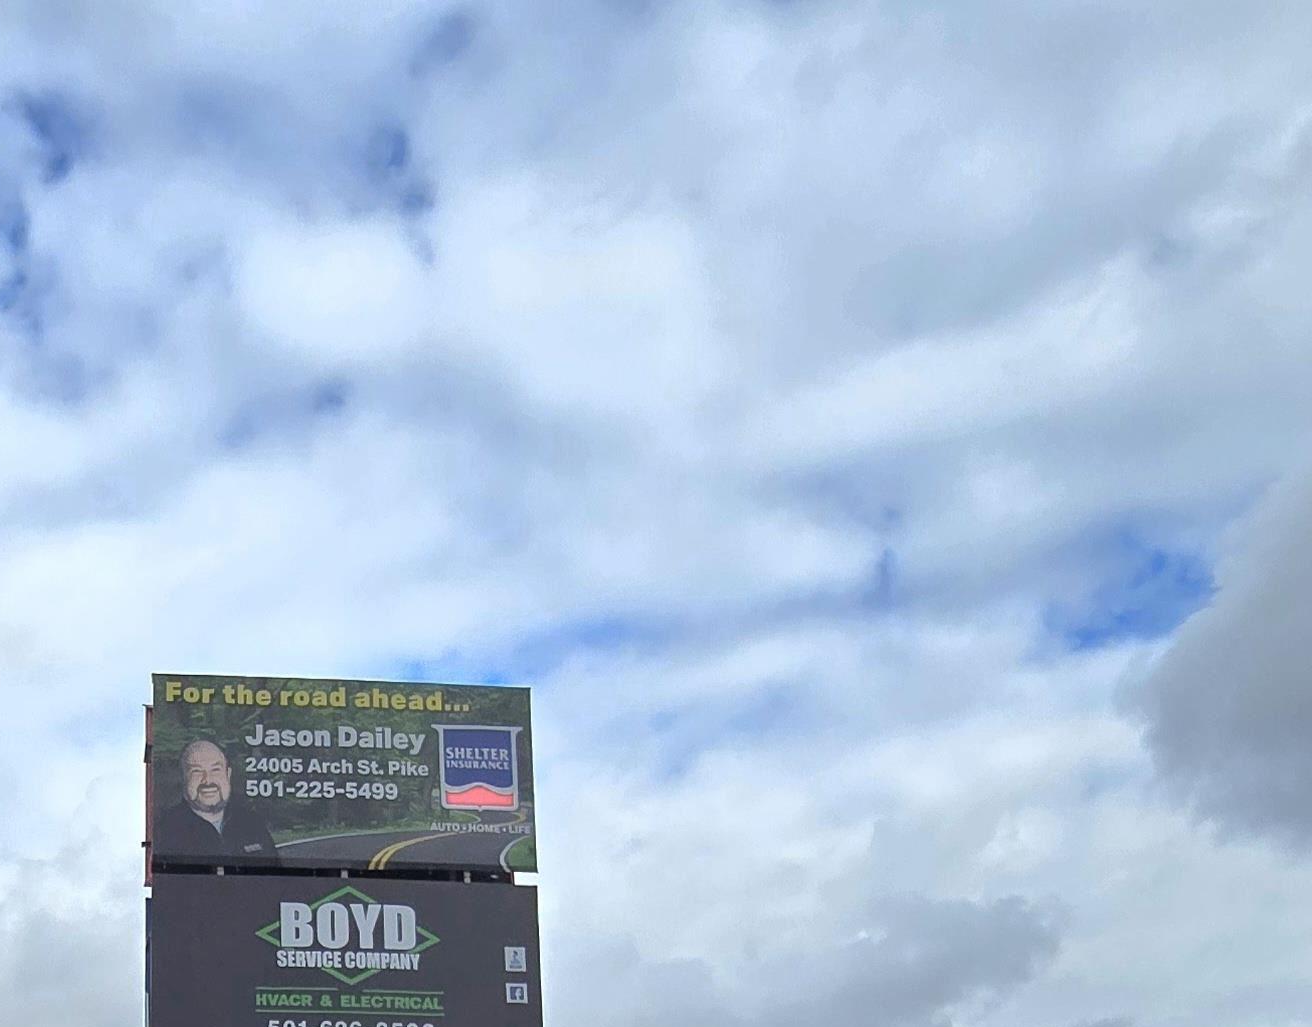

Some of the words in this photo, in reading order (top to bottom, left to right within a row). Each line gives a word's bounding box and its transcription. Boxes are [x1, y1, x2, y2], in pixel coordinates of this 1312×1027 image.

[166, 681, 214, 704] For
[223, 684, 272, 706] the
[280, 686, 346, 707] road
[354, 688, 469, 712] ahead...
[245, 724, 331, 747] Jason
[338, 726, 426, 755] Dailey
[445, 747, 509, 760] SHELTER
[245, 757, 303, 773] 24005
[307, 759, 353, 774] Arch
[357, 760, 384, 775] St.
[388, 761, 429, 776] Pike
[446, 760, 509, 770] INSURANCE
[246, 780, 398, 800] 501-225-5499
[430, 823, 460, 832] AUTO
[468, 824, 501, 834] HOME
[280, 902, 416, 950] BOYD
[277, 951, 342, 968] SERVICE
[345, 952, 420, 970] COMPANY
[255, 994, 313, 1006] HVACR
[320, 995, 333, 1007] &
[340, 995, 443, 1009] ELECTRICAL
